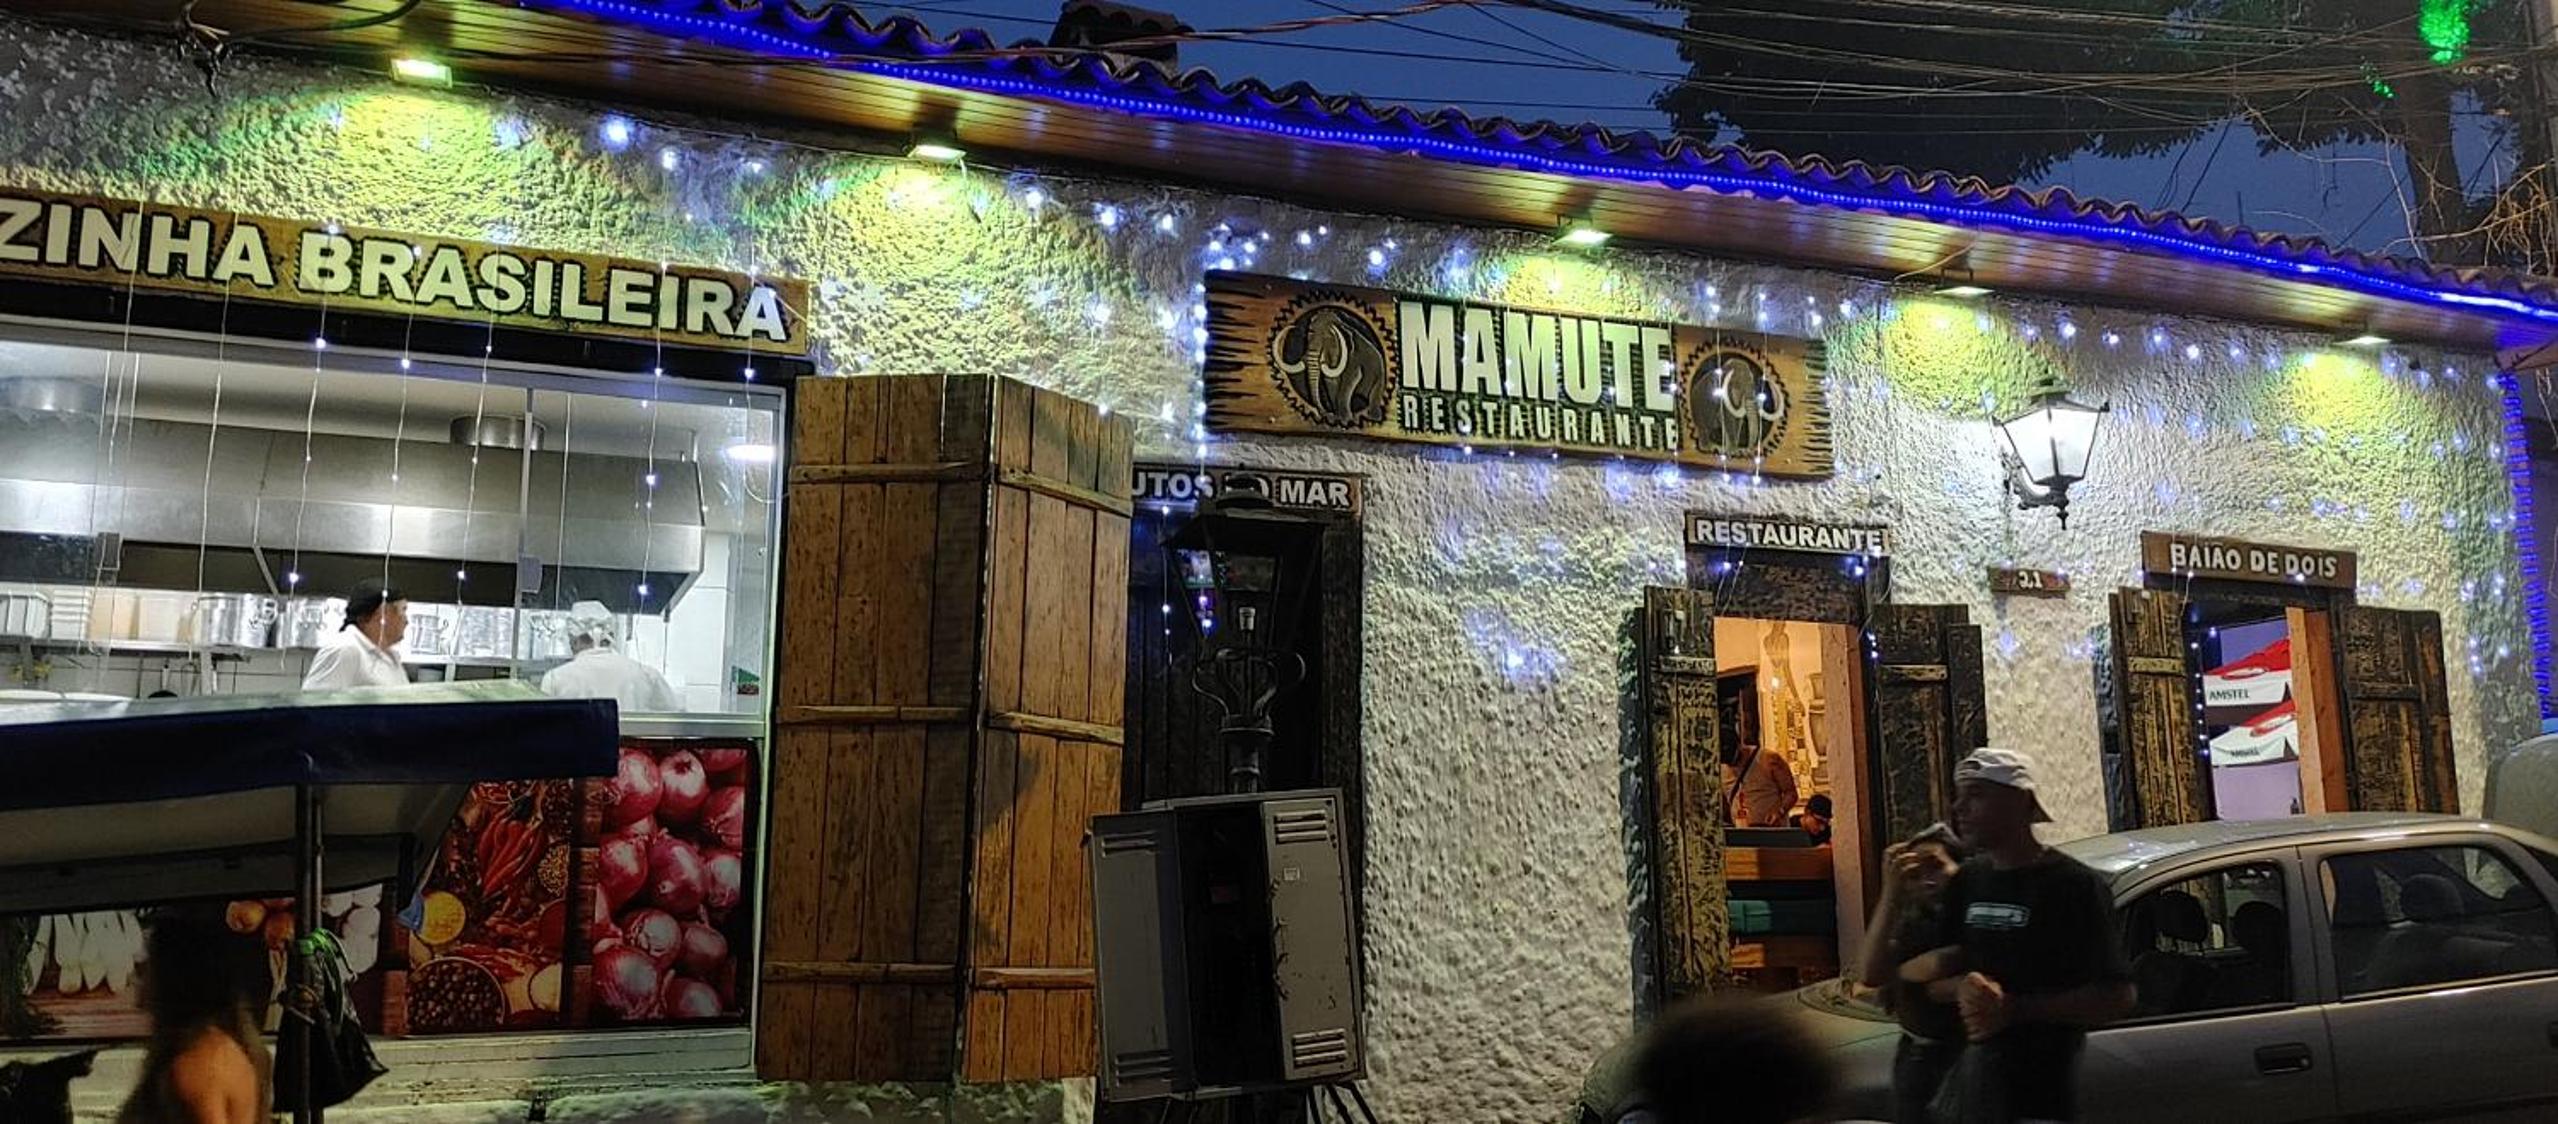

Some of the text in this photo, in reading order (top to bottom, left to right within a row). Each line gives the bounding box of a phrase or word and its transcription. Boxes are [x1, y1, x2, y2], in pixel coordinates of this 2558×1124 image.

[0, 198, 787, 341] ZINHA BRASILEIRA
[1400, 301, 1674, 412] MAMUTE
[1403, 395, 1678, 449] RESTAURANTE
[1279, 479, 1350, 506] MAR
[1696, 519, 1881, 549] RESTAURANTE
[2250, 550, 2279, 574] DE
[2209, 688, 2250, 701] AMSTEL
